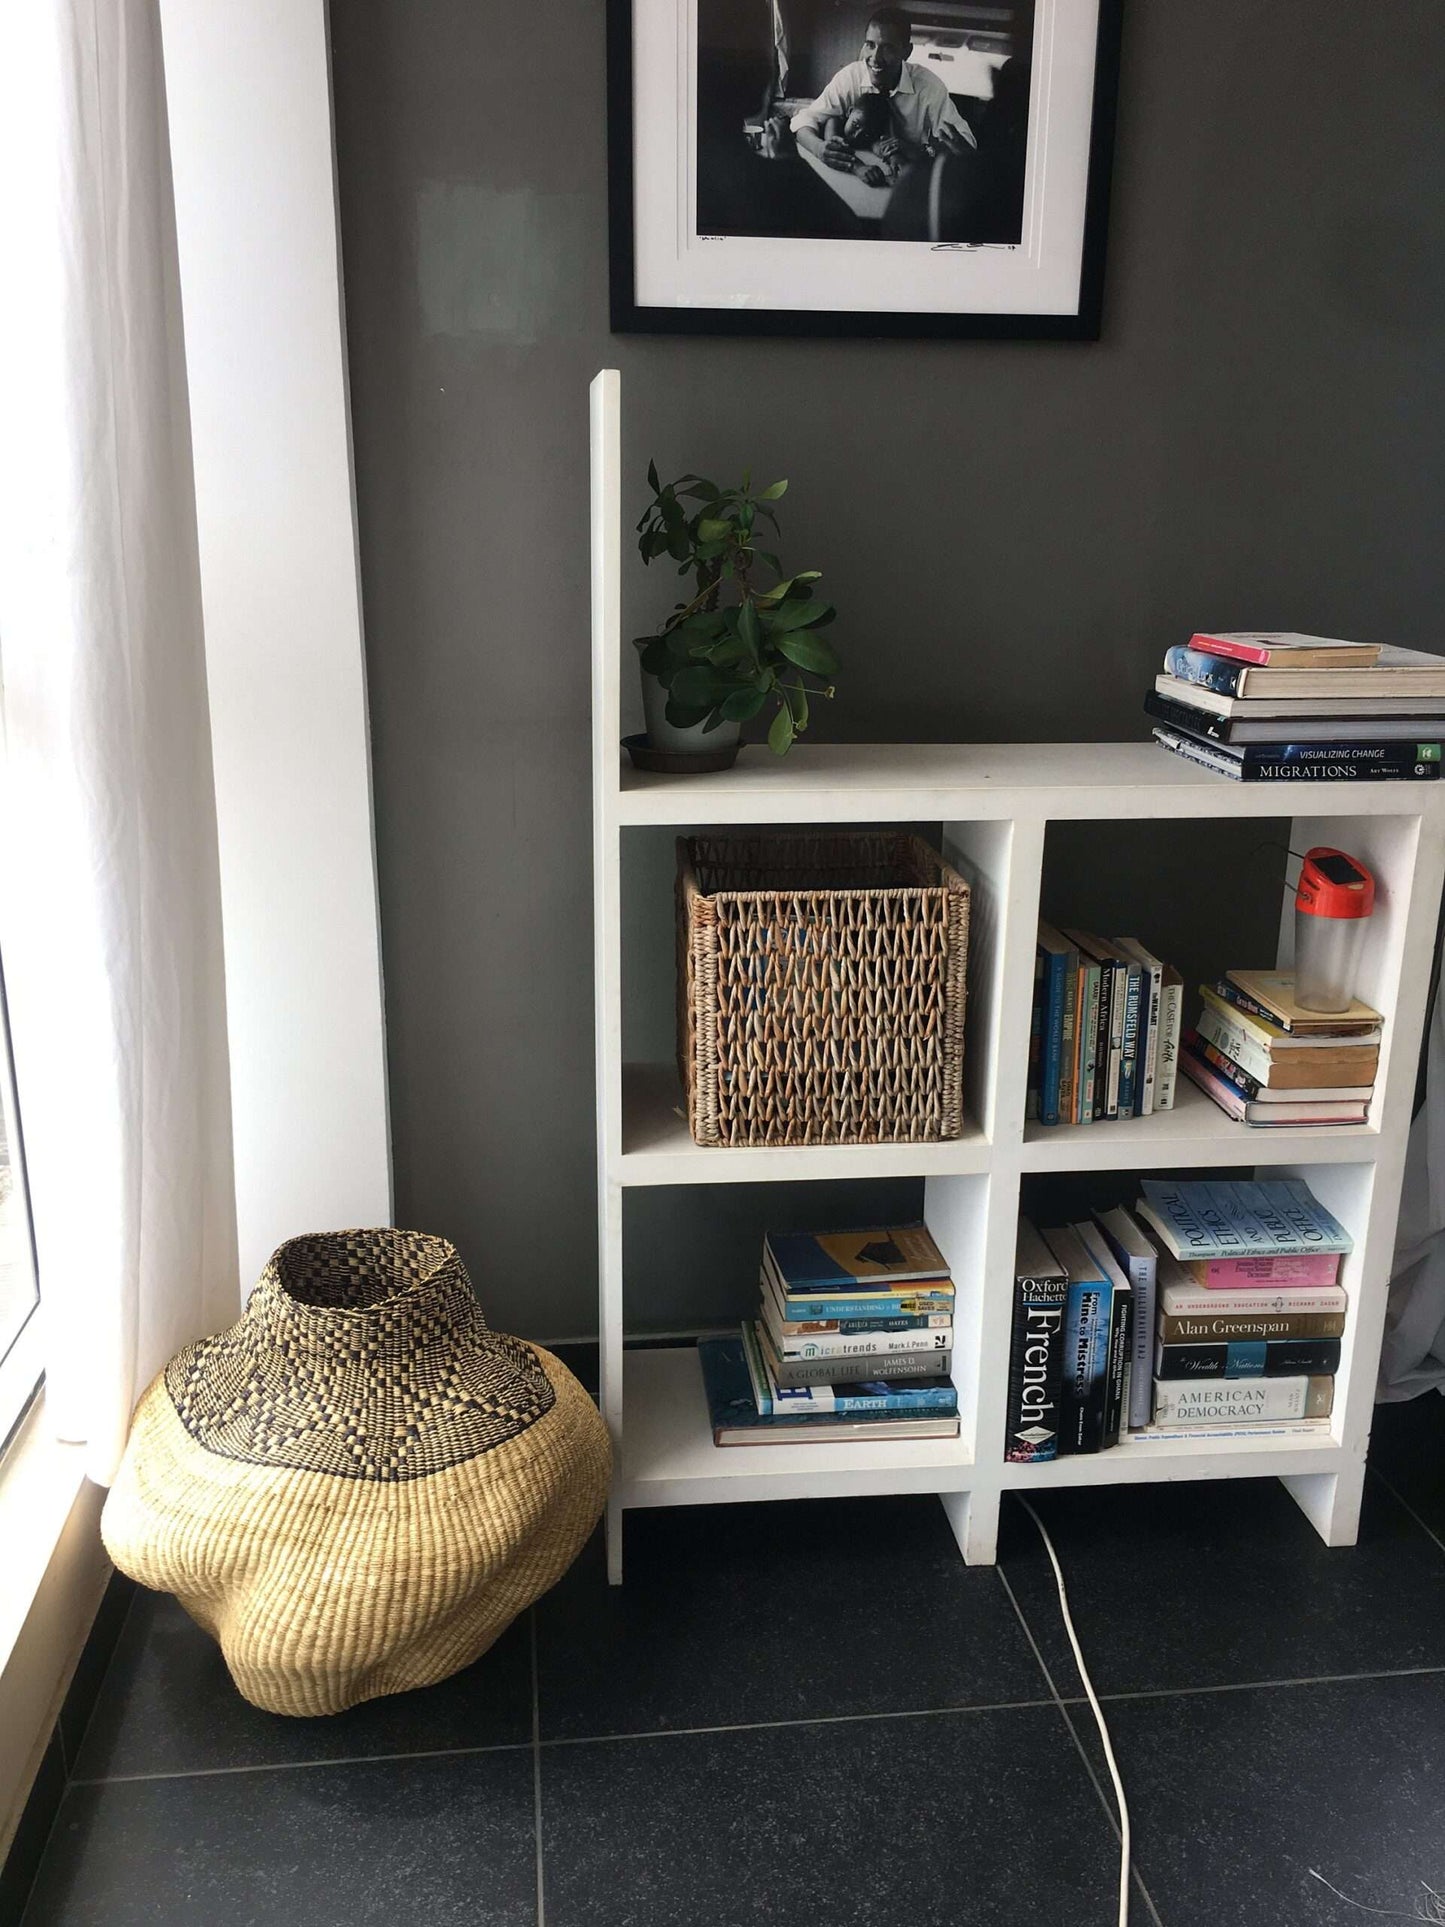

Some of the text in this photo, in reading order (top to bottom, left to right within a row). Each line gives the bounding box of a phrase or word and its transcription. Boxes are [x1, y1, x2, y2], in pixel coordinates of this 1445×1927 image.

[1351, 749, 1385, 758] CHANGE
[1260, 765, 1357, 777] MIGRATIONS
[1099, 967, 1110, 1031] Modern Africa
[1123, 975, 1140, 1059] THE RUMSFELD WAY
[1166, 1002, 1177, 1023] CASE
[1052, 1019, 1060, 1043] WORLD
[1063, 1014, 1073, 1041] EMPIRE
[1162, 1039, 1175, 1063] faith
[1161, 1192, 1211, 1248] POLITICAL
[1198, 1208, 1240, 1247] ETHICS
[1254, 1208, 1297, 1243] PUBLIC
[1282, 1207, 1324, 1242] OFFICE
[1245, 1226, 1265, 1243] AND
[1022, 1278, 1068, 1292] Oxford
[1023, 1292, 1066, 1302] Hachette
[1091, 1292, 1100, 1315] From
[826, 1303, 885, 1313] UNDERSTANDING
[1120, 1304, 1128, 1332] FIGHTING
[1137, 1266, 1148, 1360] THE BILLIONAIRE RAJ
[1173, 1320, 1290, 1336] Alan Greenspan
[801, 1341, 878, 1359] microtrends
[888, 1341, 904, 1350] Mark
[911, 1340, 929, 1349] Penn
[1076, 1292, 1093, 1394] Mine to Mistress
[1117, 1333, 1126, 1372] CORRUPTION
[787, 1364, 861, 1380] A GLOBAL LIFE
[872, 1363, 927, 1376] WOLFENSOHN
[883, 1356, 916, 1367] JAMES D.
[1020, 1307, 1062, 1423] French
[1185, 1360, 1219, 1370] Wealth
[1114, 1379, 1123, 1400] GHANA
[1178, 1390, 1266, 1404] AMERICAN
[843, 1398, 887, 1411] EARTH
[1177, 1404, 1264, 1418] DEMOCRACY
